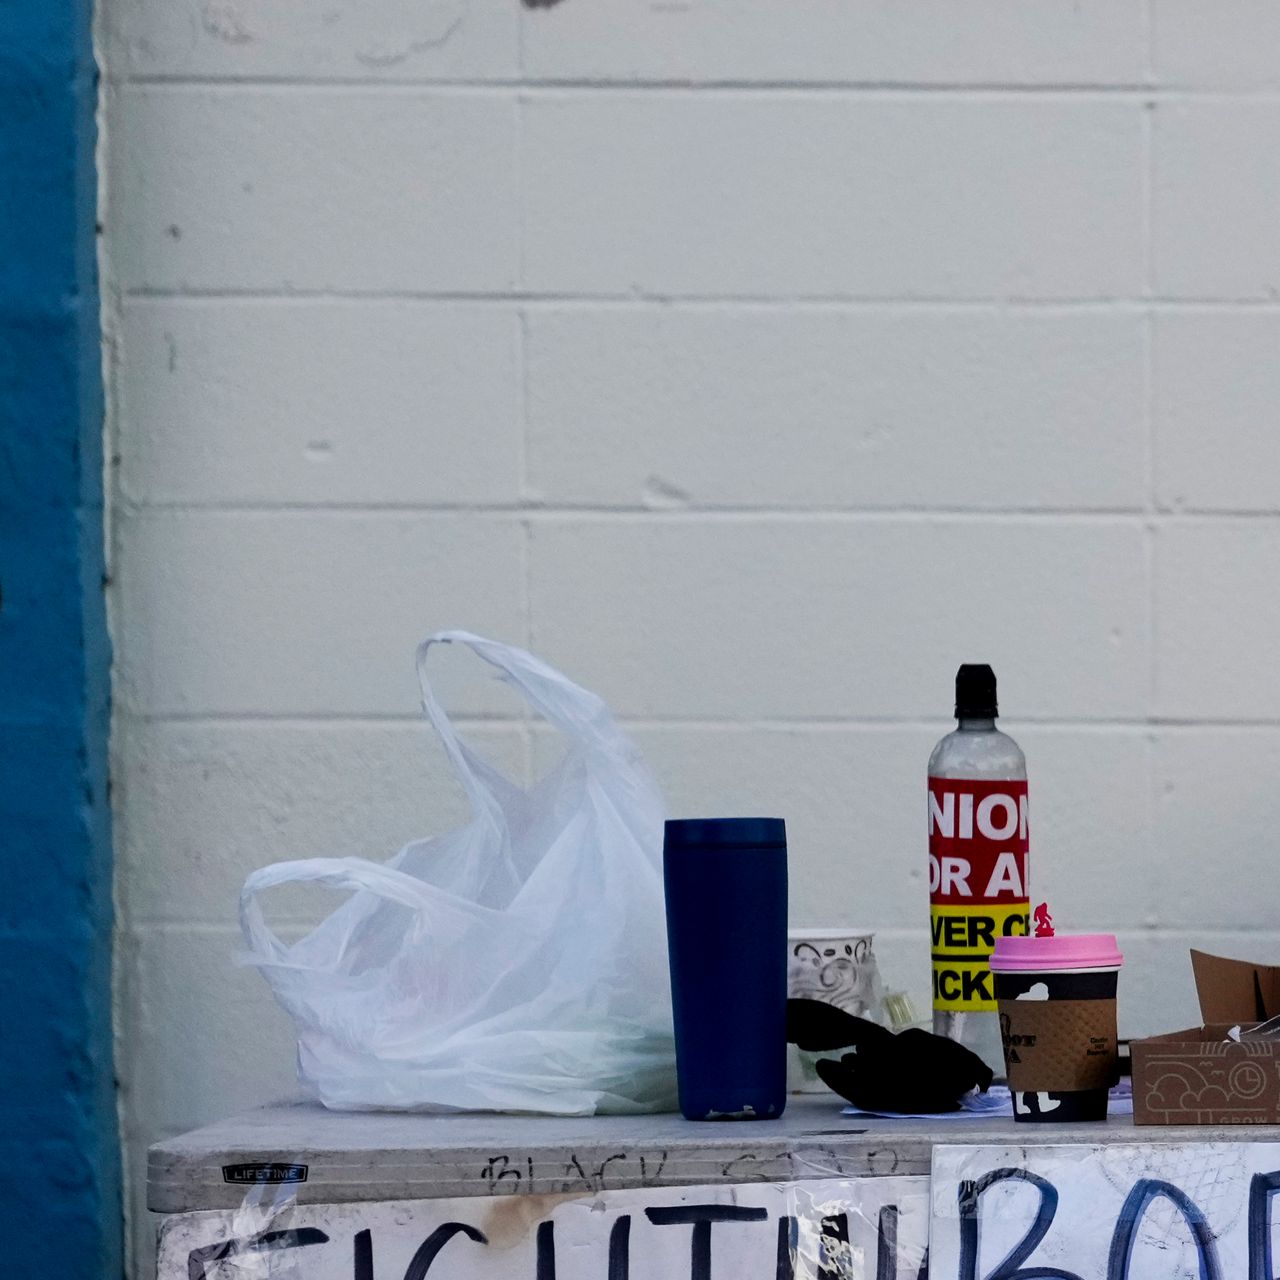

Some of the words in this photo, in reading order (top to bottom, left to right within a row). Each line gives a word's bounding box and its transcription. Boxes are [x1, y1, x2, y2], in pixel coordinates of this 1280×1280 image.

[1002, 913, 1029, 938] C
[935, 969, 998, 1001] ICK
[233, 1167, 298, 1179] LIFETIME
